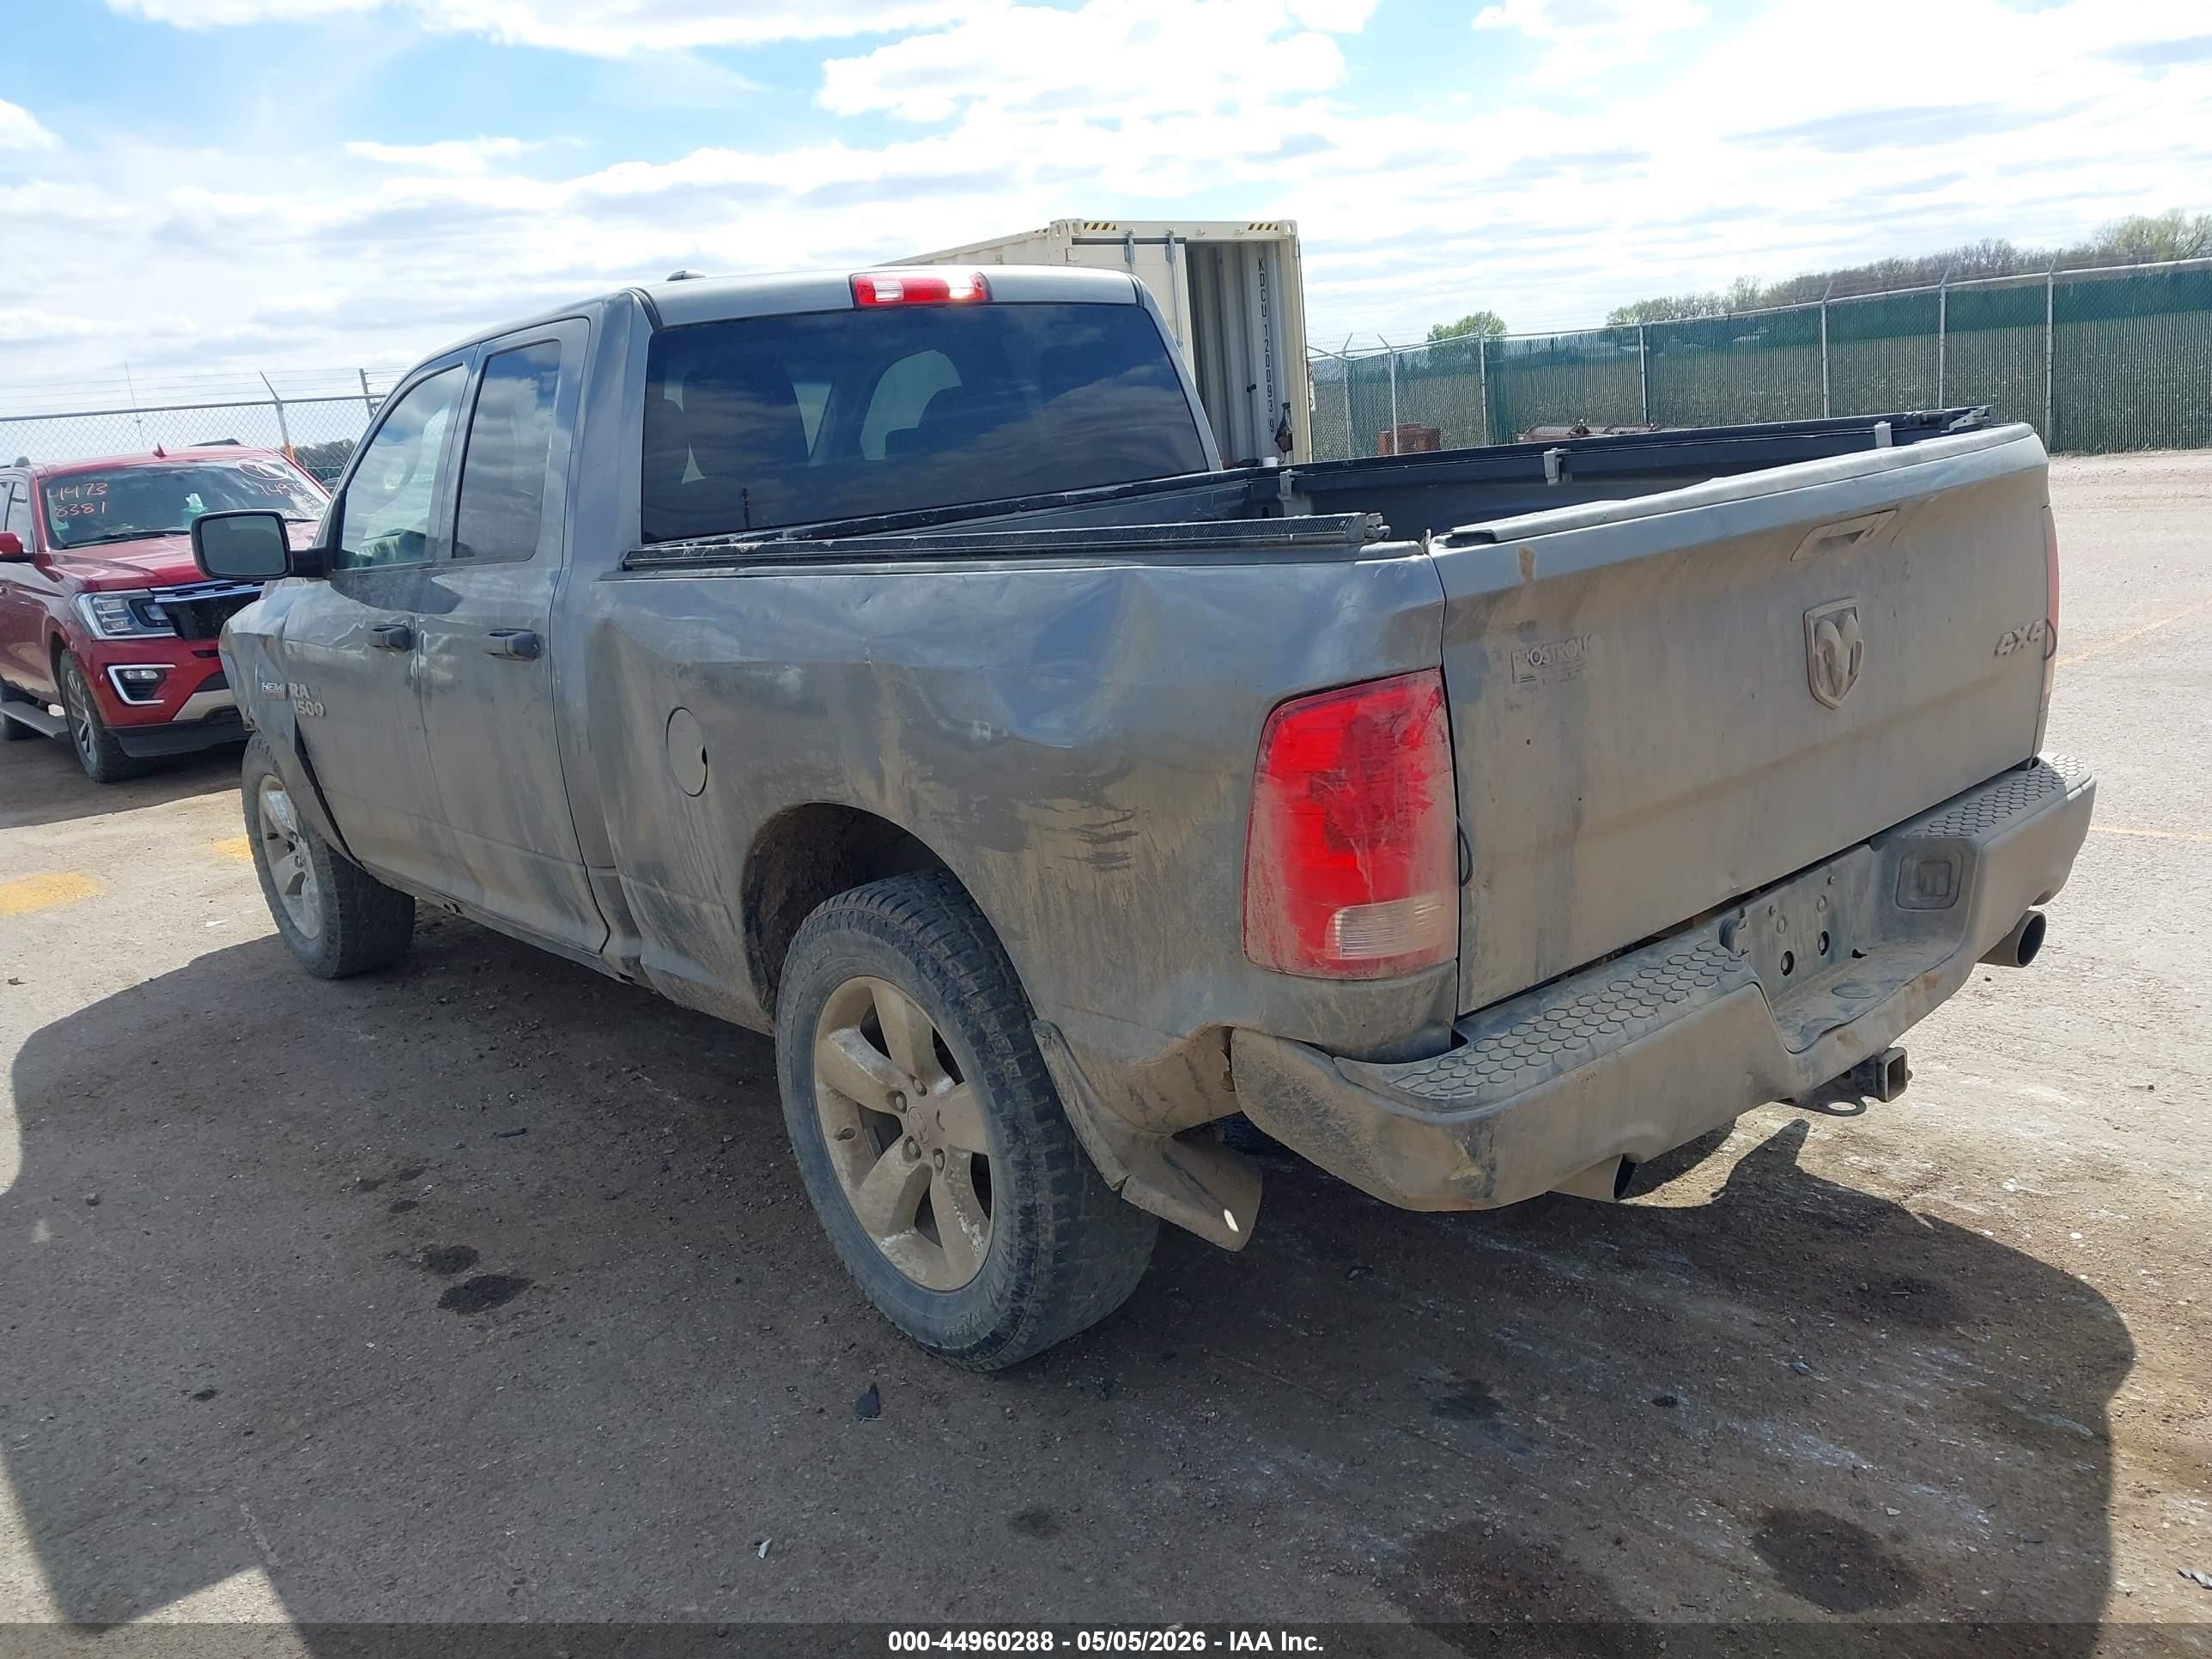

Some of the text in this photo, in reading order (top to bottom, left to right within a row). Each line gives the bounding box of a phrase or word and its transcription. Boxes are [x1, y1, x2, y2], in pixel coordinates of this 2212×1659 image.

[1257, 257, 1267, 318] KDCU
[1264, 323, 1273, 413] 120093
[55, 501, 106, 517] 8381
